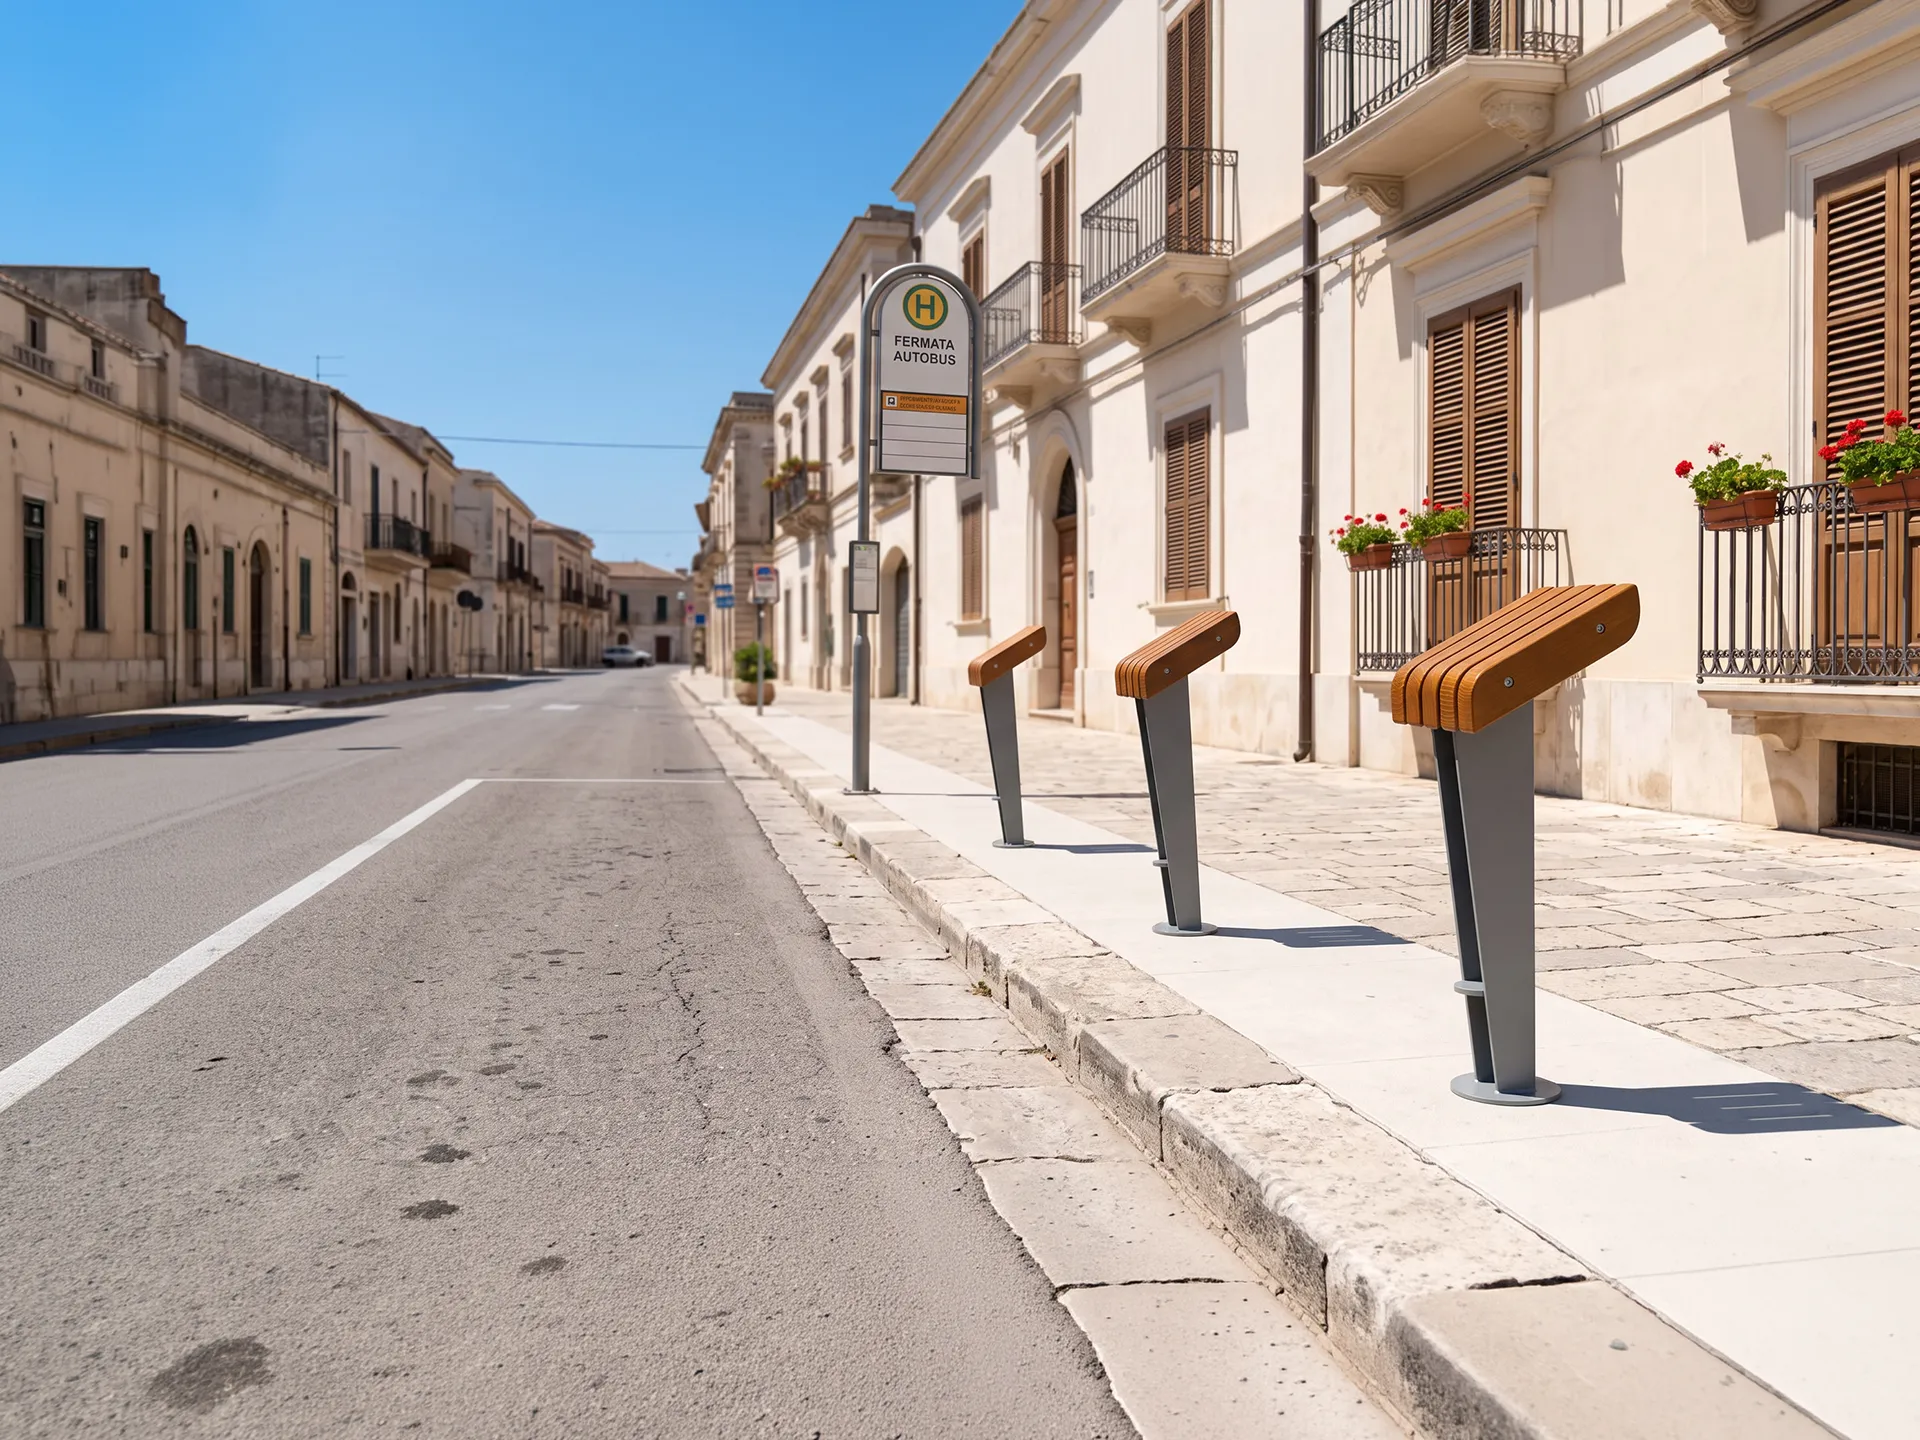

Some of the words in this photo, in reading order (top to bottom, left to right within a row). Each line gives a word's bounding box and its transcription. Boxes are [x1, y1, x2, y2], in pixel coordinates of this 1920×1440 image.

[916, 294, 935, 320] H
[894, 335, 955, 350] FERMATA
[893, 351, 956, 366] AUTOBUS
